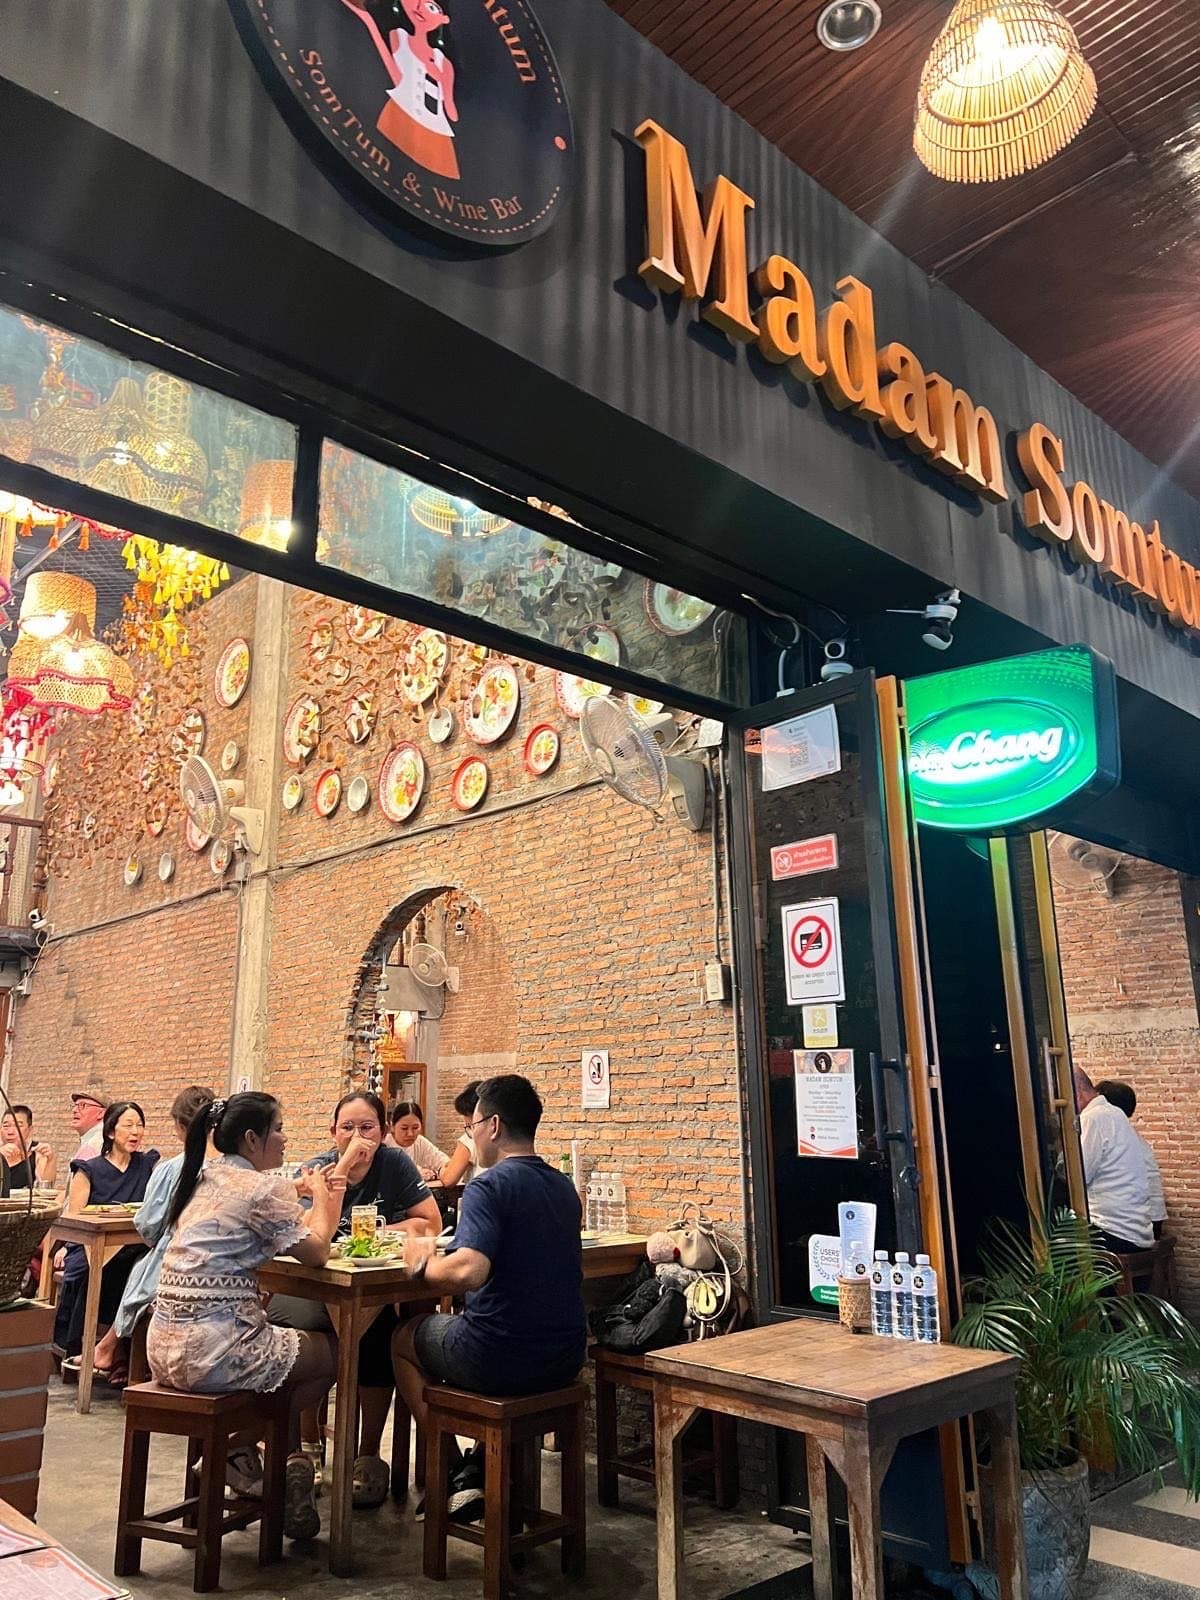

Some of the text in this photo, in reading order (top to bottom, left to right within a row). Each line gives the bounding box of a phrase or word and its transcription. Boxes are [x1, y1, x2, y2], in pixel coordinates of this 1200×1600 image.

[402, 172, 423, 197] &
[432, 186, 489, 222] Wine
[490, 195, 522, 220] Bar
[635, 119, 1008, 501] Madam
[949, 726, 1064, 771] Chang
